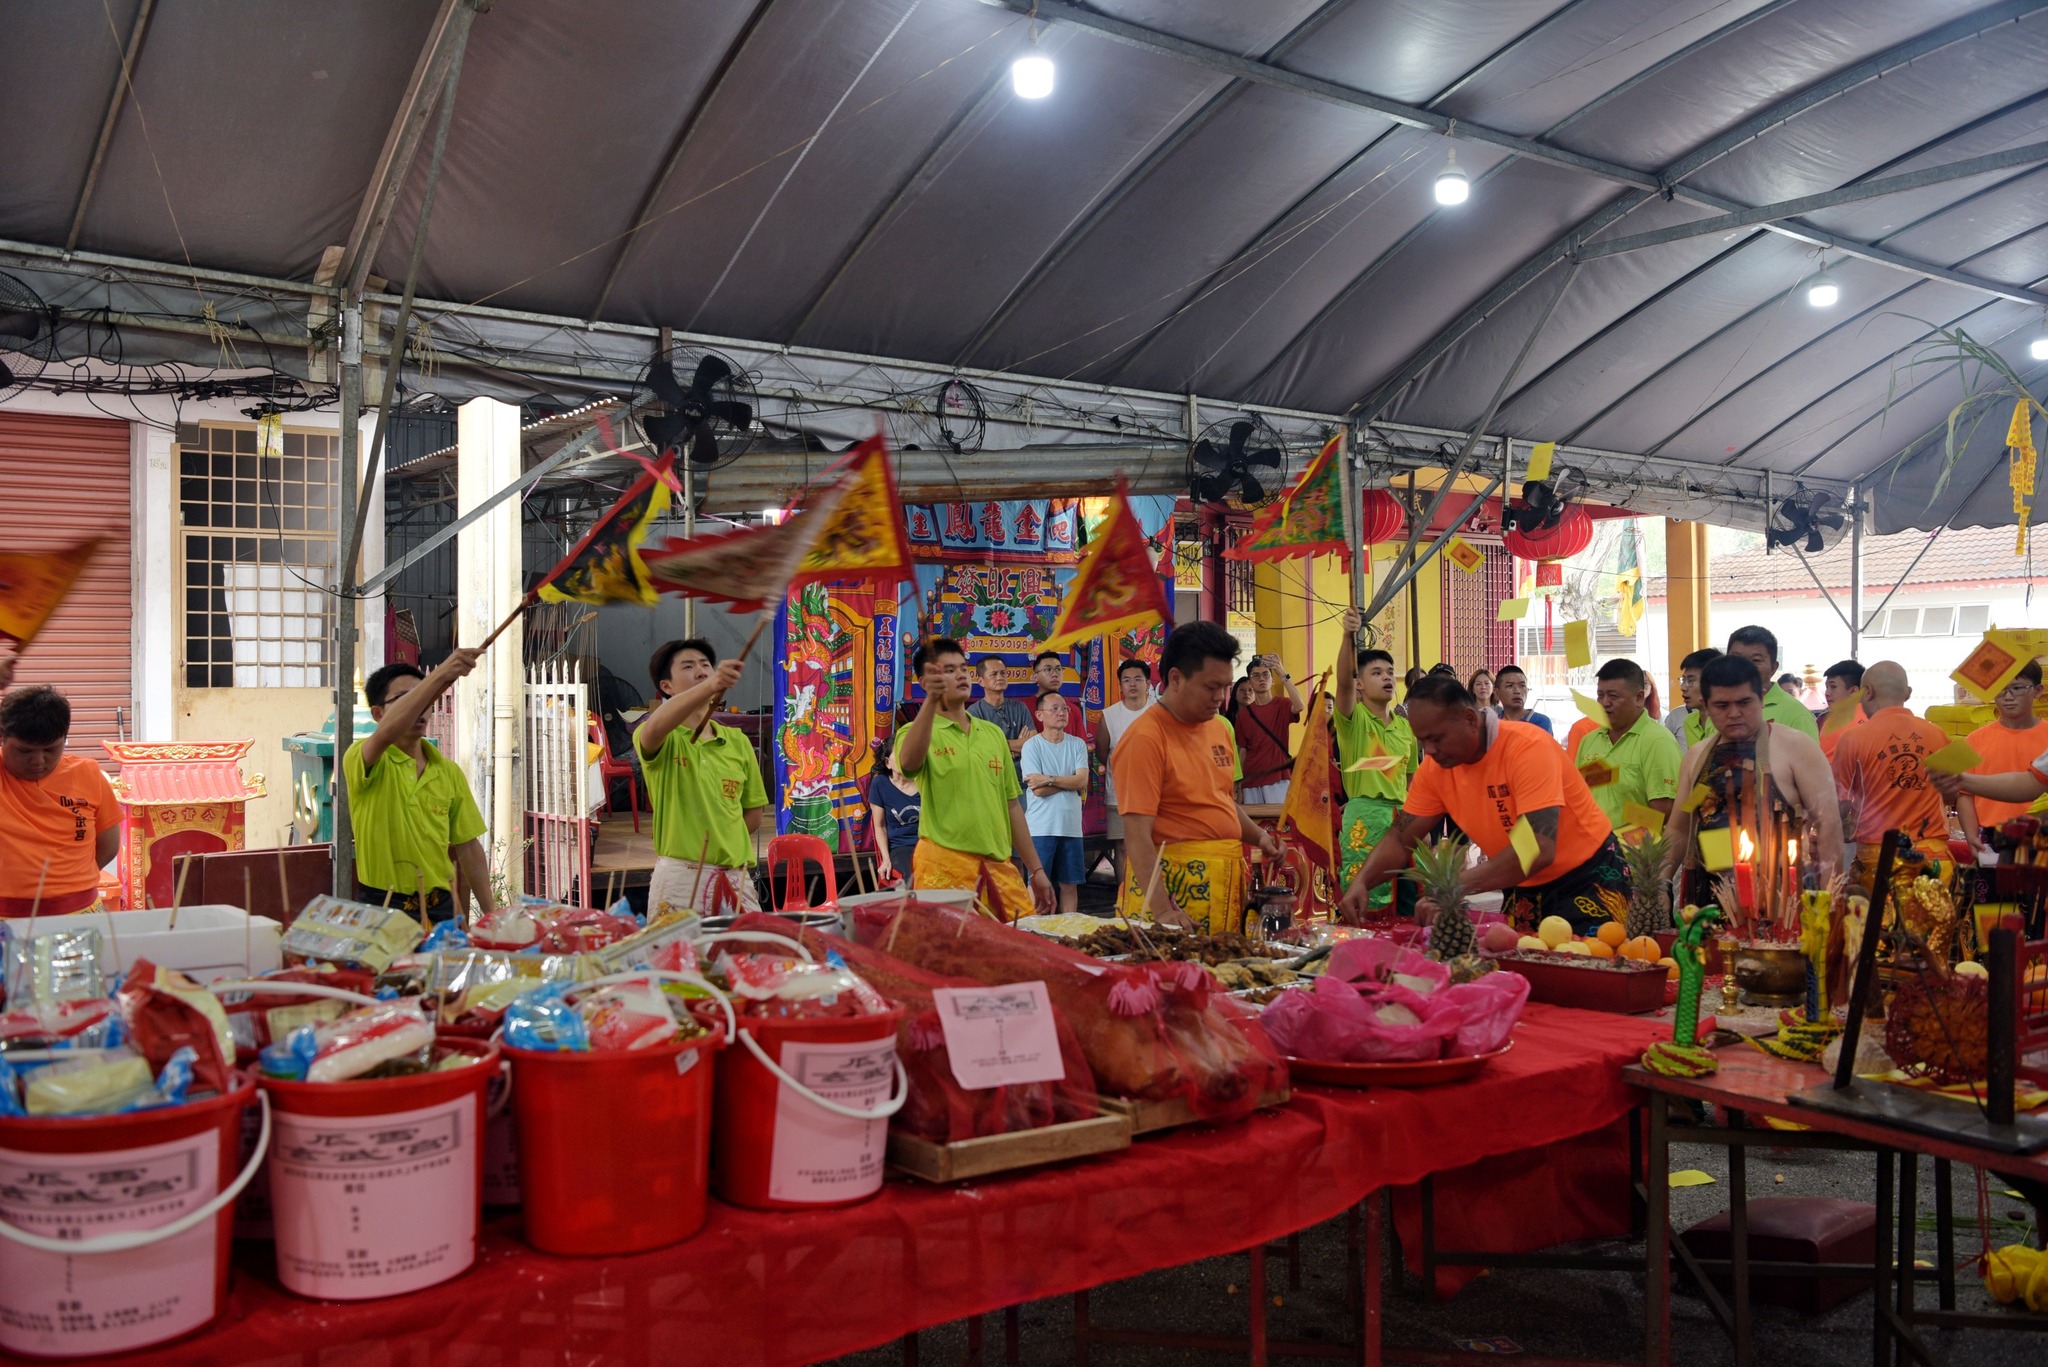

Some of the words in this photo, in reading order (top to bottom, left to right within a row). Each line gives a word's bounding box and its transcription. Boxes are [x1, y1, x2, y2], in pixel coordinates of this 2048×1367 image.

[877, 617, 894, 706] 五福臨門
[970, 639, 1028, 650] 017-7590198
